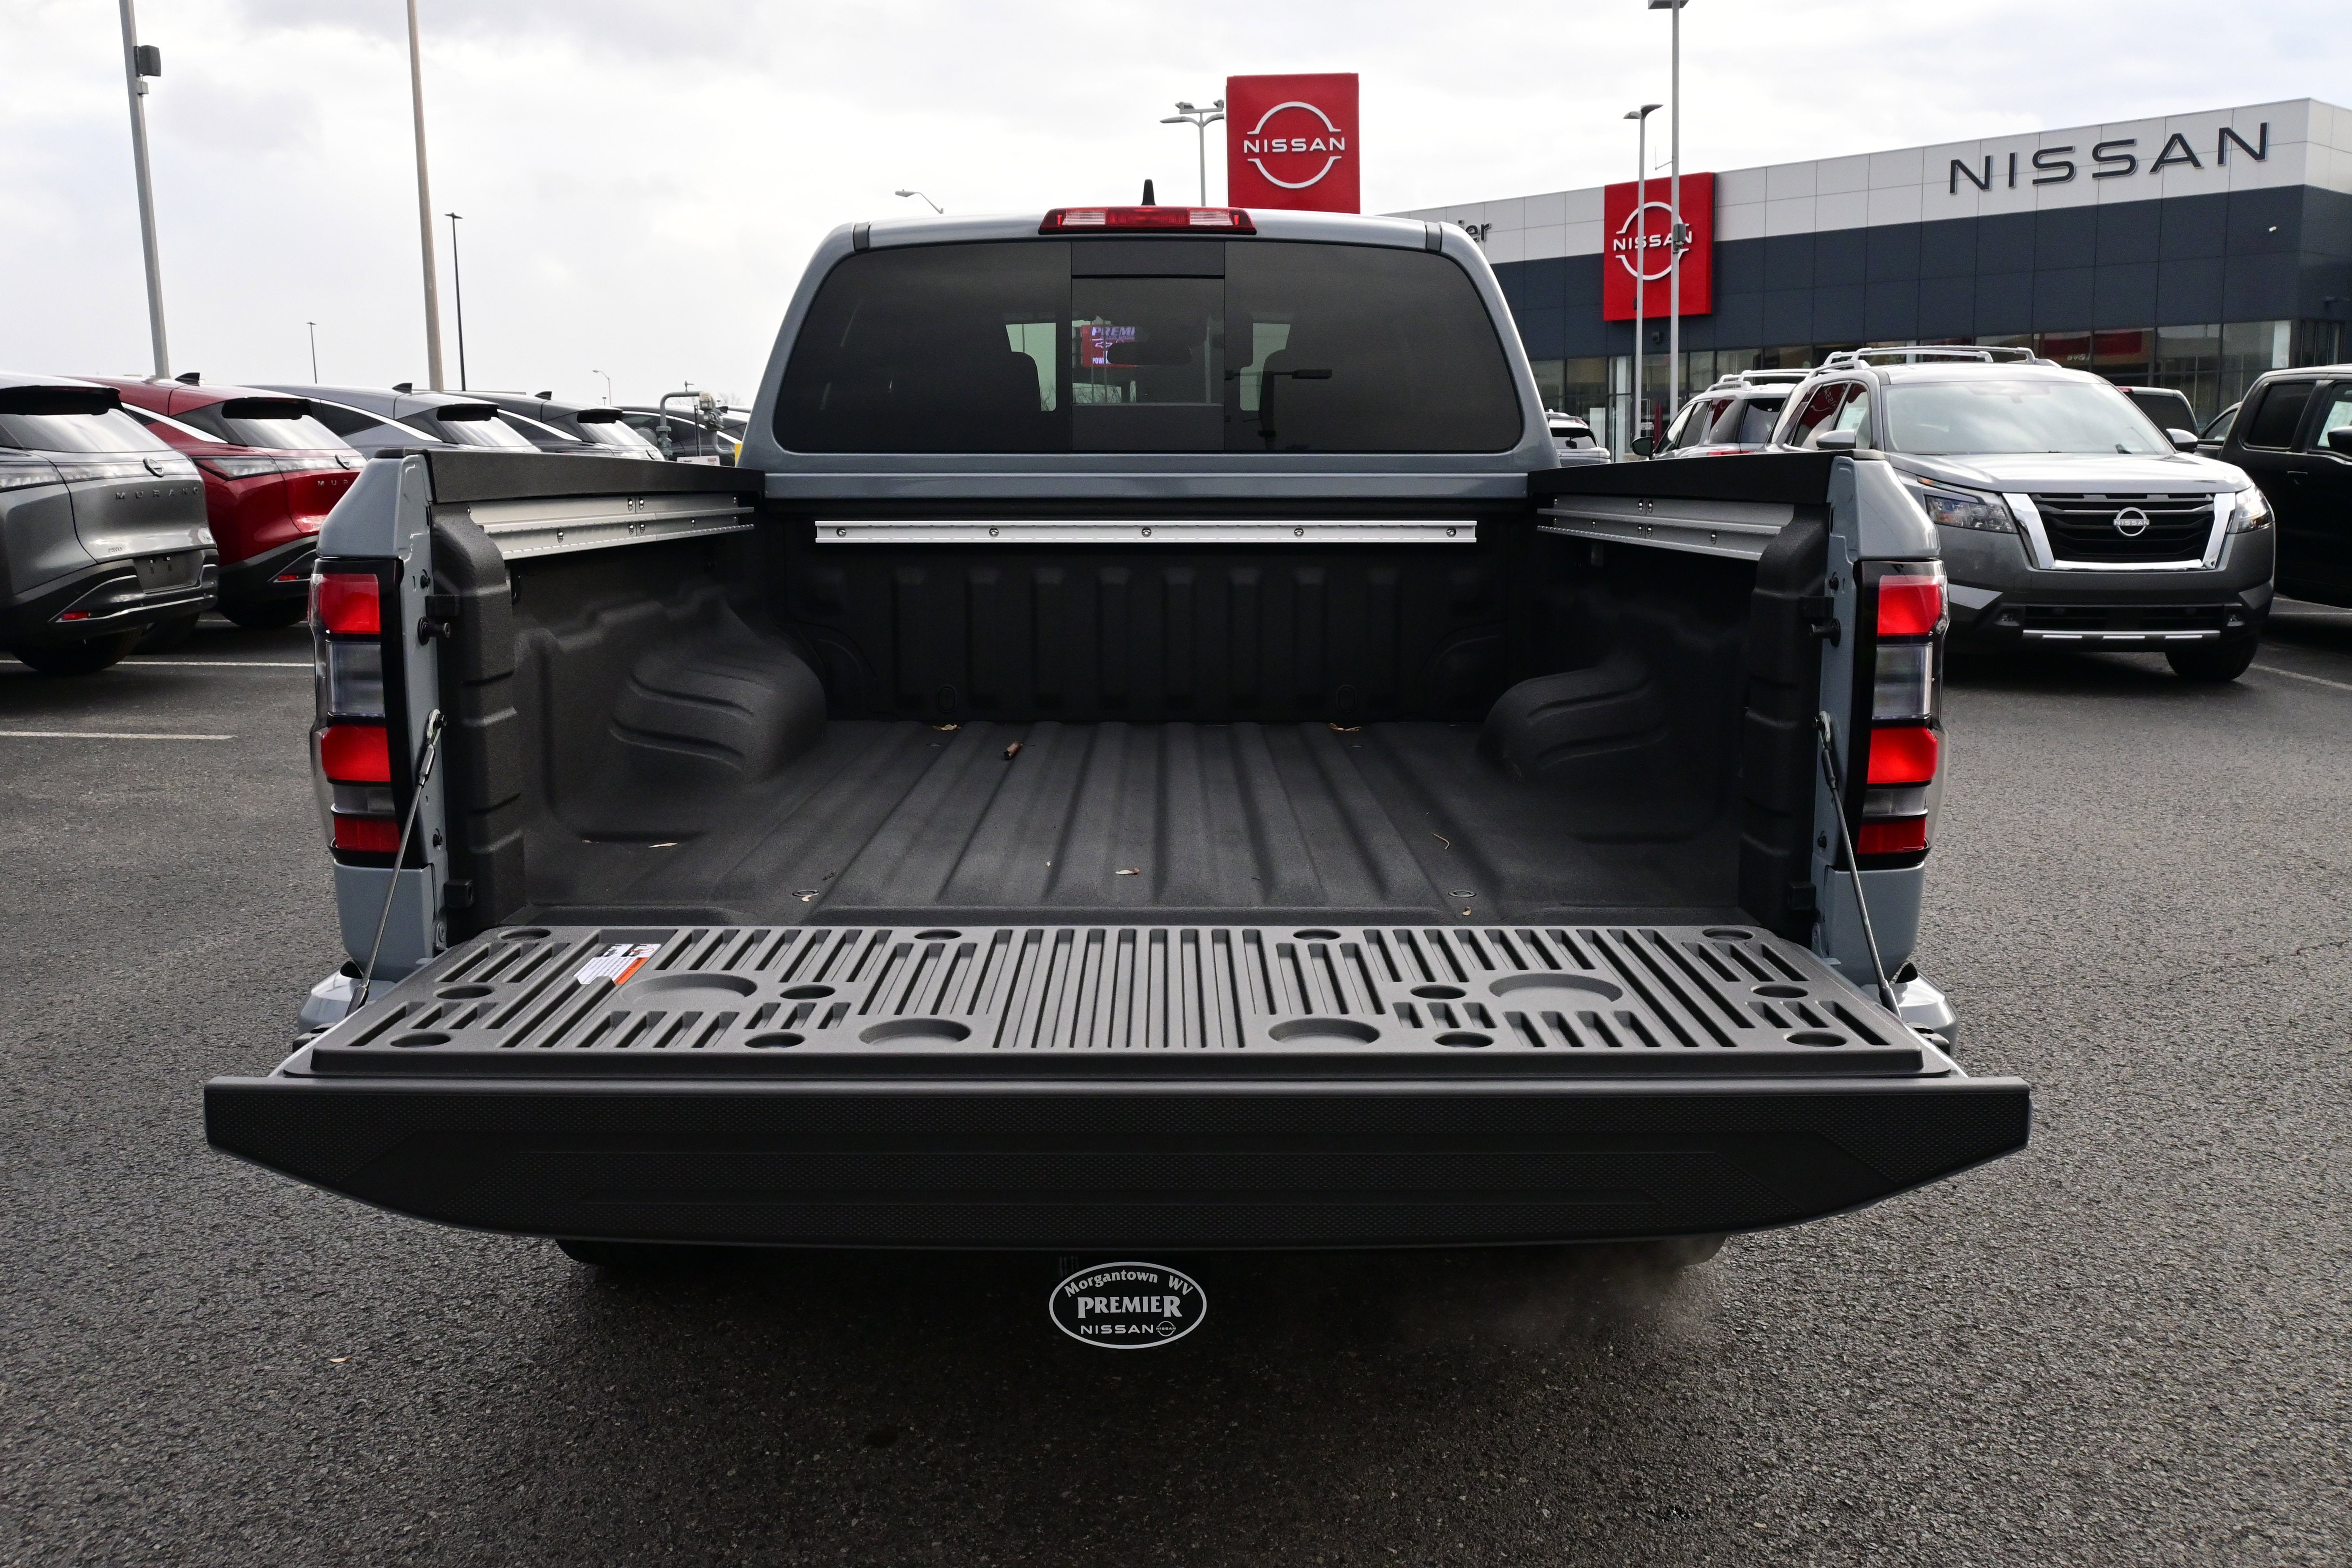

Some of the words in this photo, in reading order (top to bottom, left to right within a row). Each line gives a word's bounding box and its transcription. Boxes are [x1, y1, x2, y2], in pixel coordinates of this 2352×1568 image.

[1244, 137, 1345, 153] NISSAN
[1949, 121, 2269, 195] NISSAN
[115, 487, 198, 500] MURANO
[1064, 1269, 1158, 1298] Morgantown
[1168, 1275, 1194, 1296] WV
[1077, 1296, 1183, 1318] PREMIER
[1081, 1324, 1154, 1334] NISSAN
